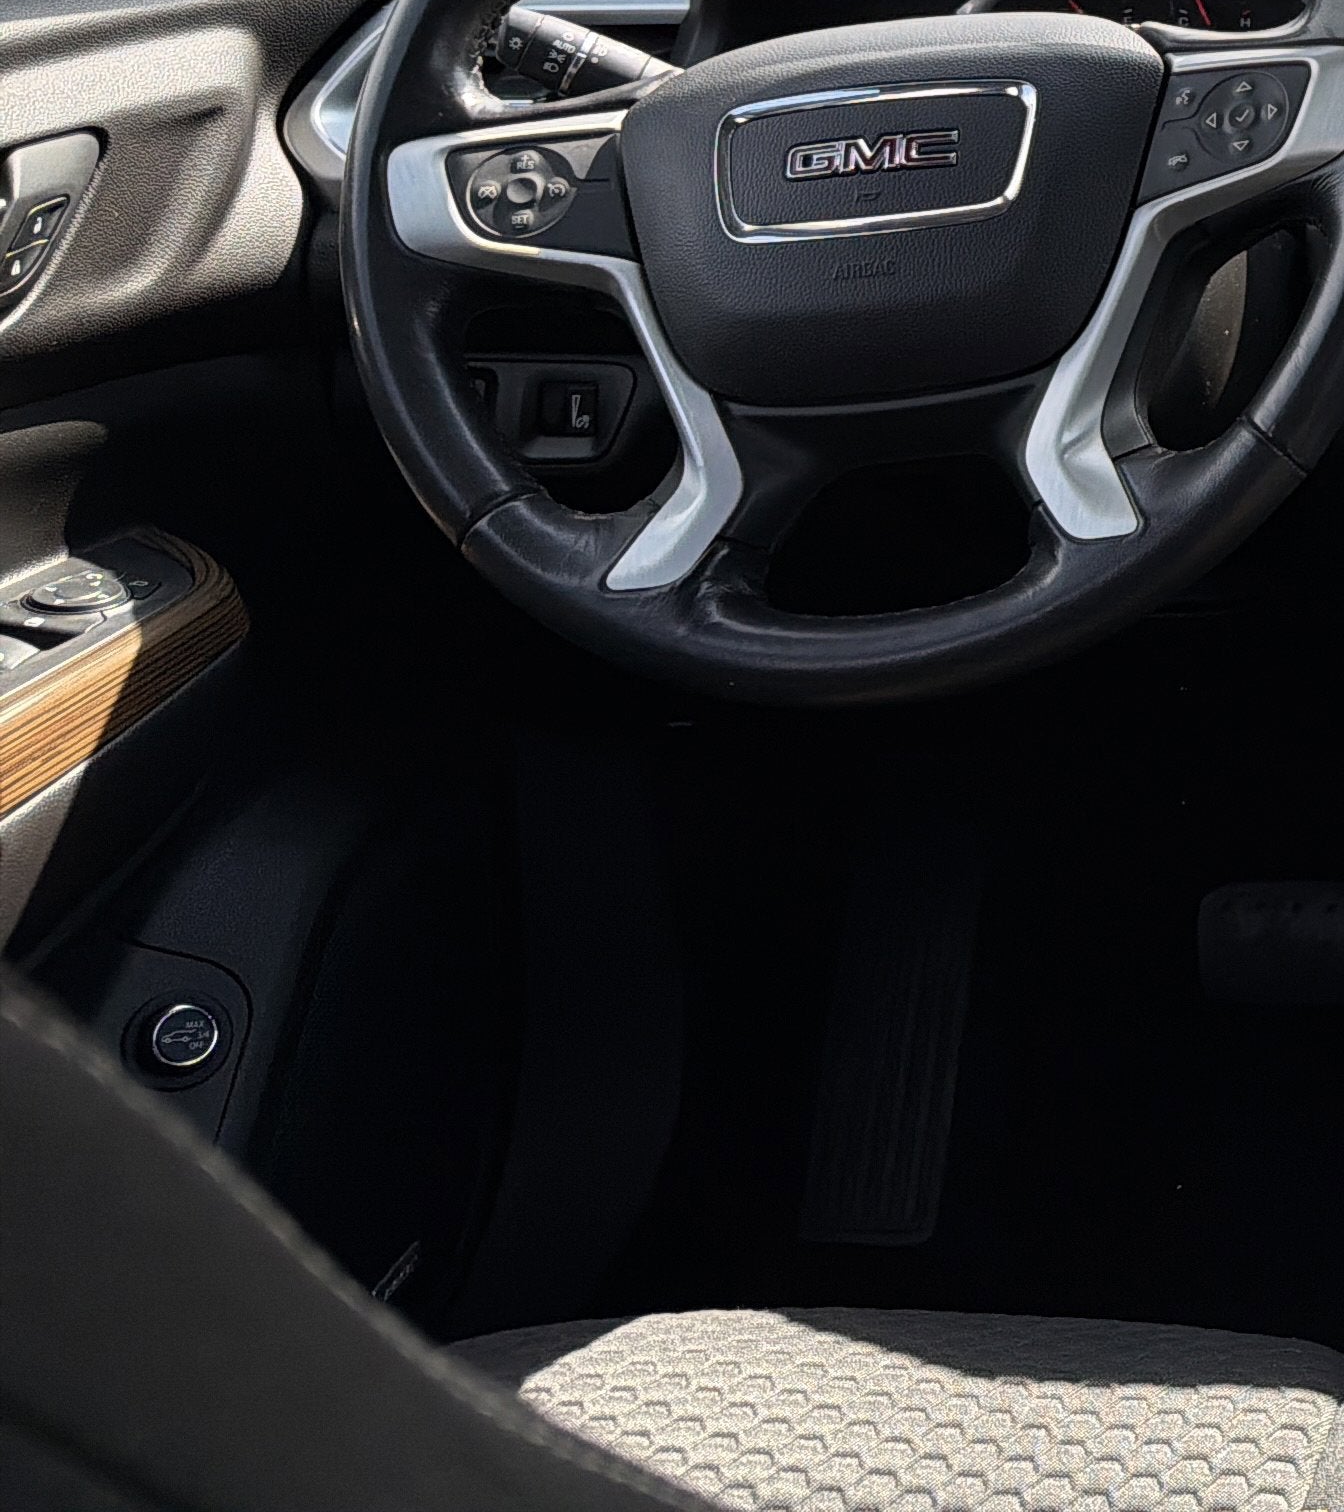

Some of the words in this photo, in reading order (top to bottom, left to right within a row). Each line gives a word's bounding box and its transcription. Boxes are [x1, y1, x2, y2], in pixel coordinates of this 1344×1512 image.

[1240, 18, 1251, 28] H
[787, 129, 960, 181] GMC
[511, 215, 529, 225] SET
[832, 259, 897, 281] AIRBAG
